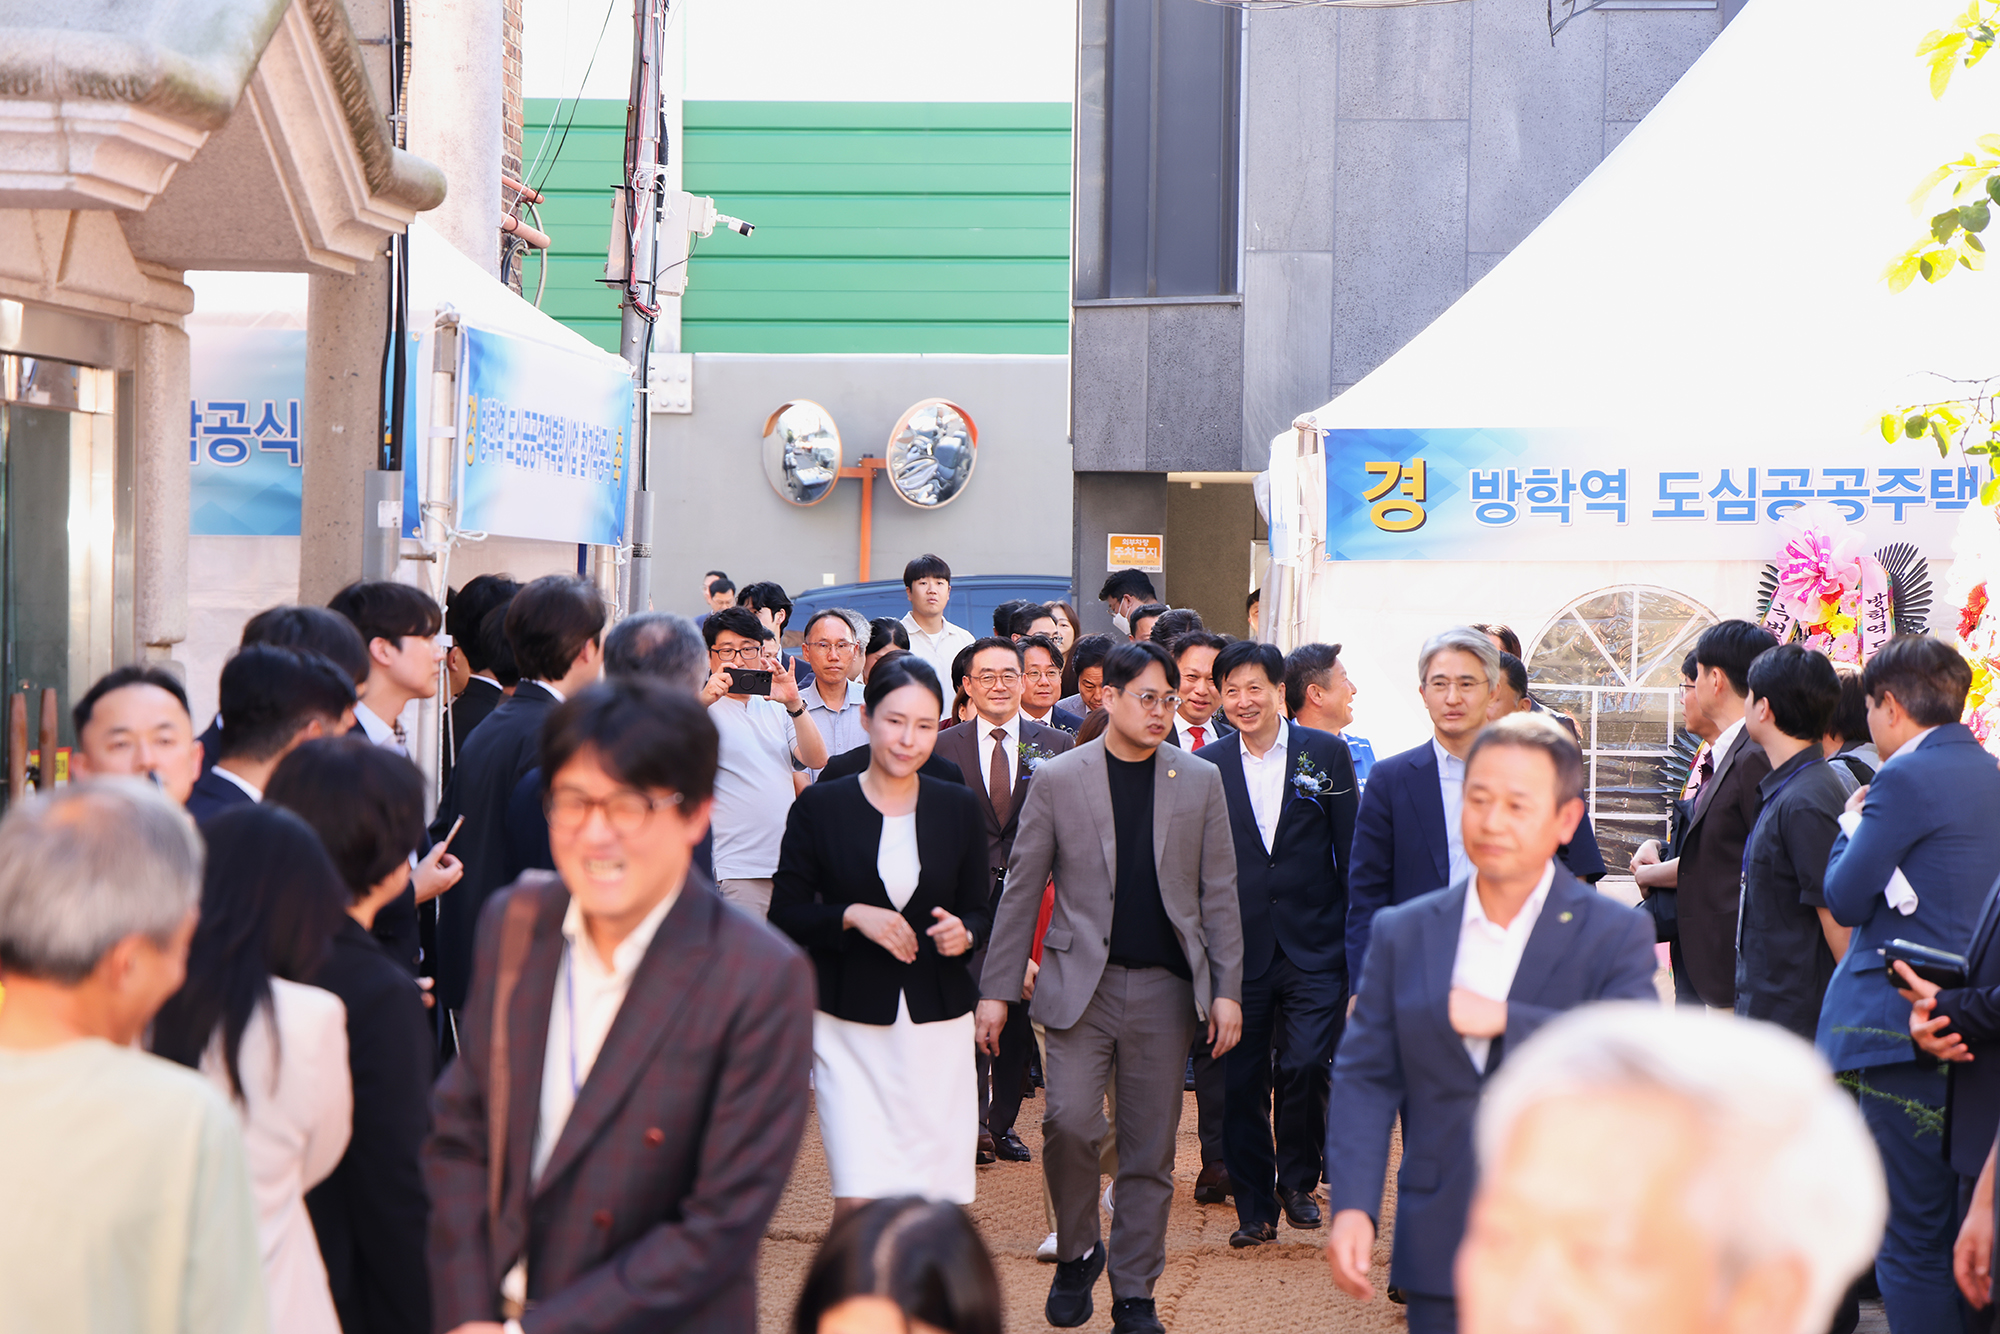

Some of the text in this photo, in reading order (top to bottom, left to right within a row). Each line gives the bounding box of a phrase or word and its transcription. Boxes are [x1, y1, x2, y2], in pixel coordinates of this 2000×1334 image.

[466, 392, 478, 467] 경
[480, 397, 507, 466] 방학역
[613, 425, 623, 490] 축
[1362, 457, 1996, 533] 경 방학역 도심공공주택
[1114, 546, 1157, 558] 주차금지
[1865, 592, 1888, 634] 방학역
